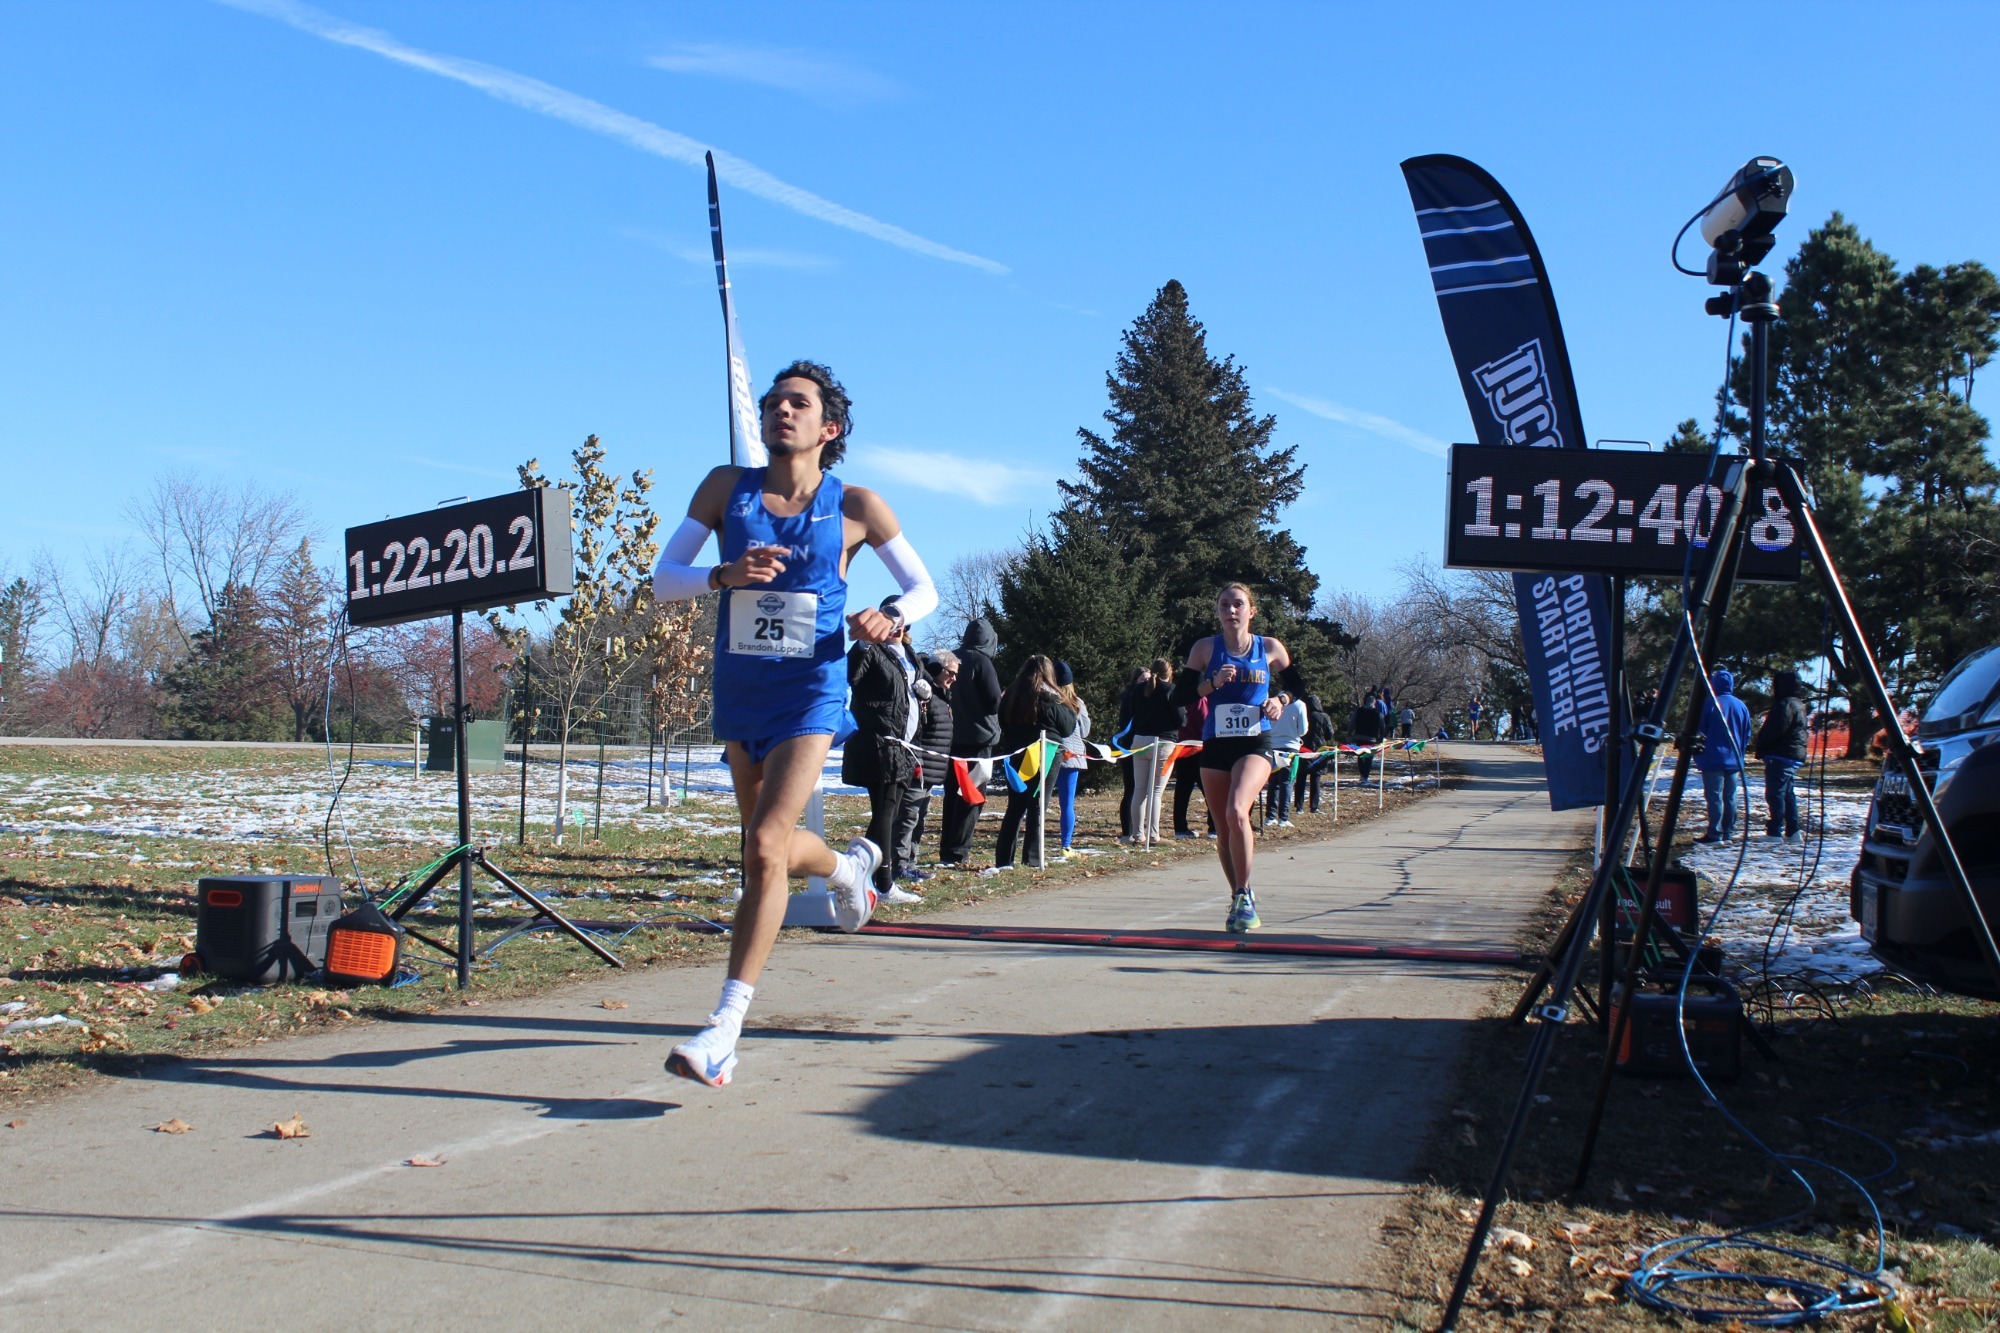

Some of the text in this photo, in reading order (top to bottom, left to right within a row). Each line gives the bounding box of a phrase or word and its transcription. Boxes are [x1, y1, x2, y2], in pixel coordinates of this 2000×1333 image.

[350, 515, 535, 600] 1:22:20.2
[754, 617, 785, 641] 25
[737, 642, 803, 655] Brandon Lopez
[1532, 576, 1577, 737] START HERE
[1240, 669, 1266, 684] LAKE
[1225, 716, 1250, 729] 310
